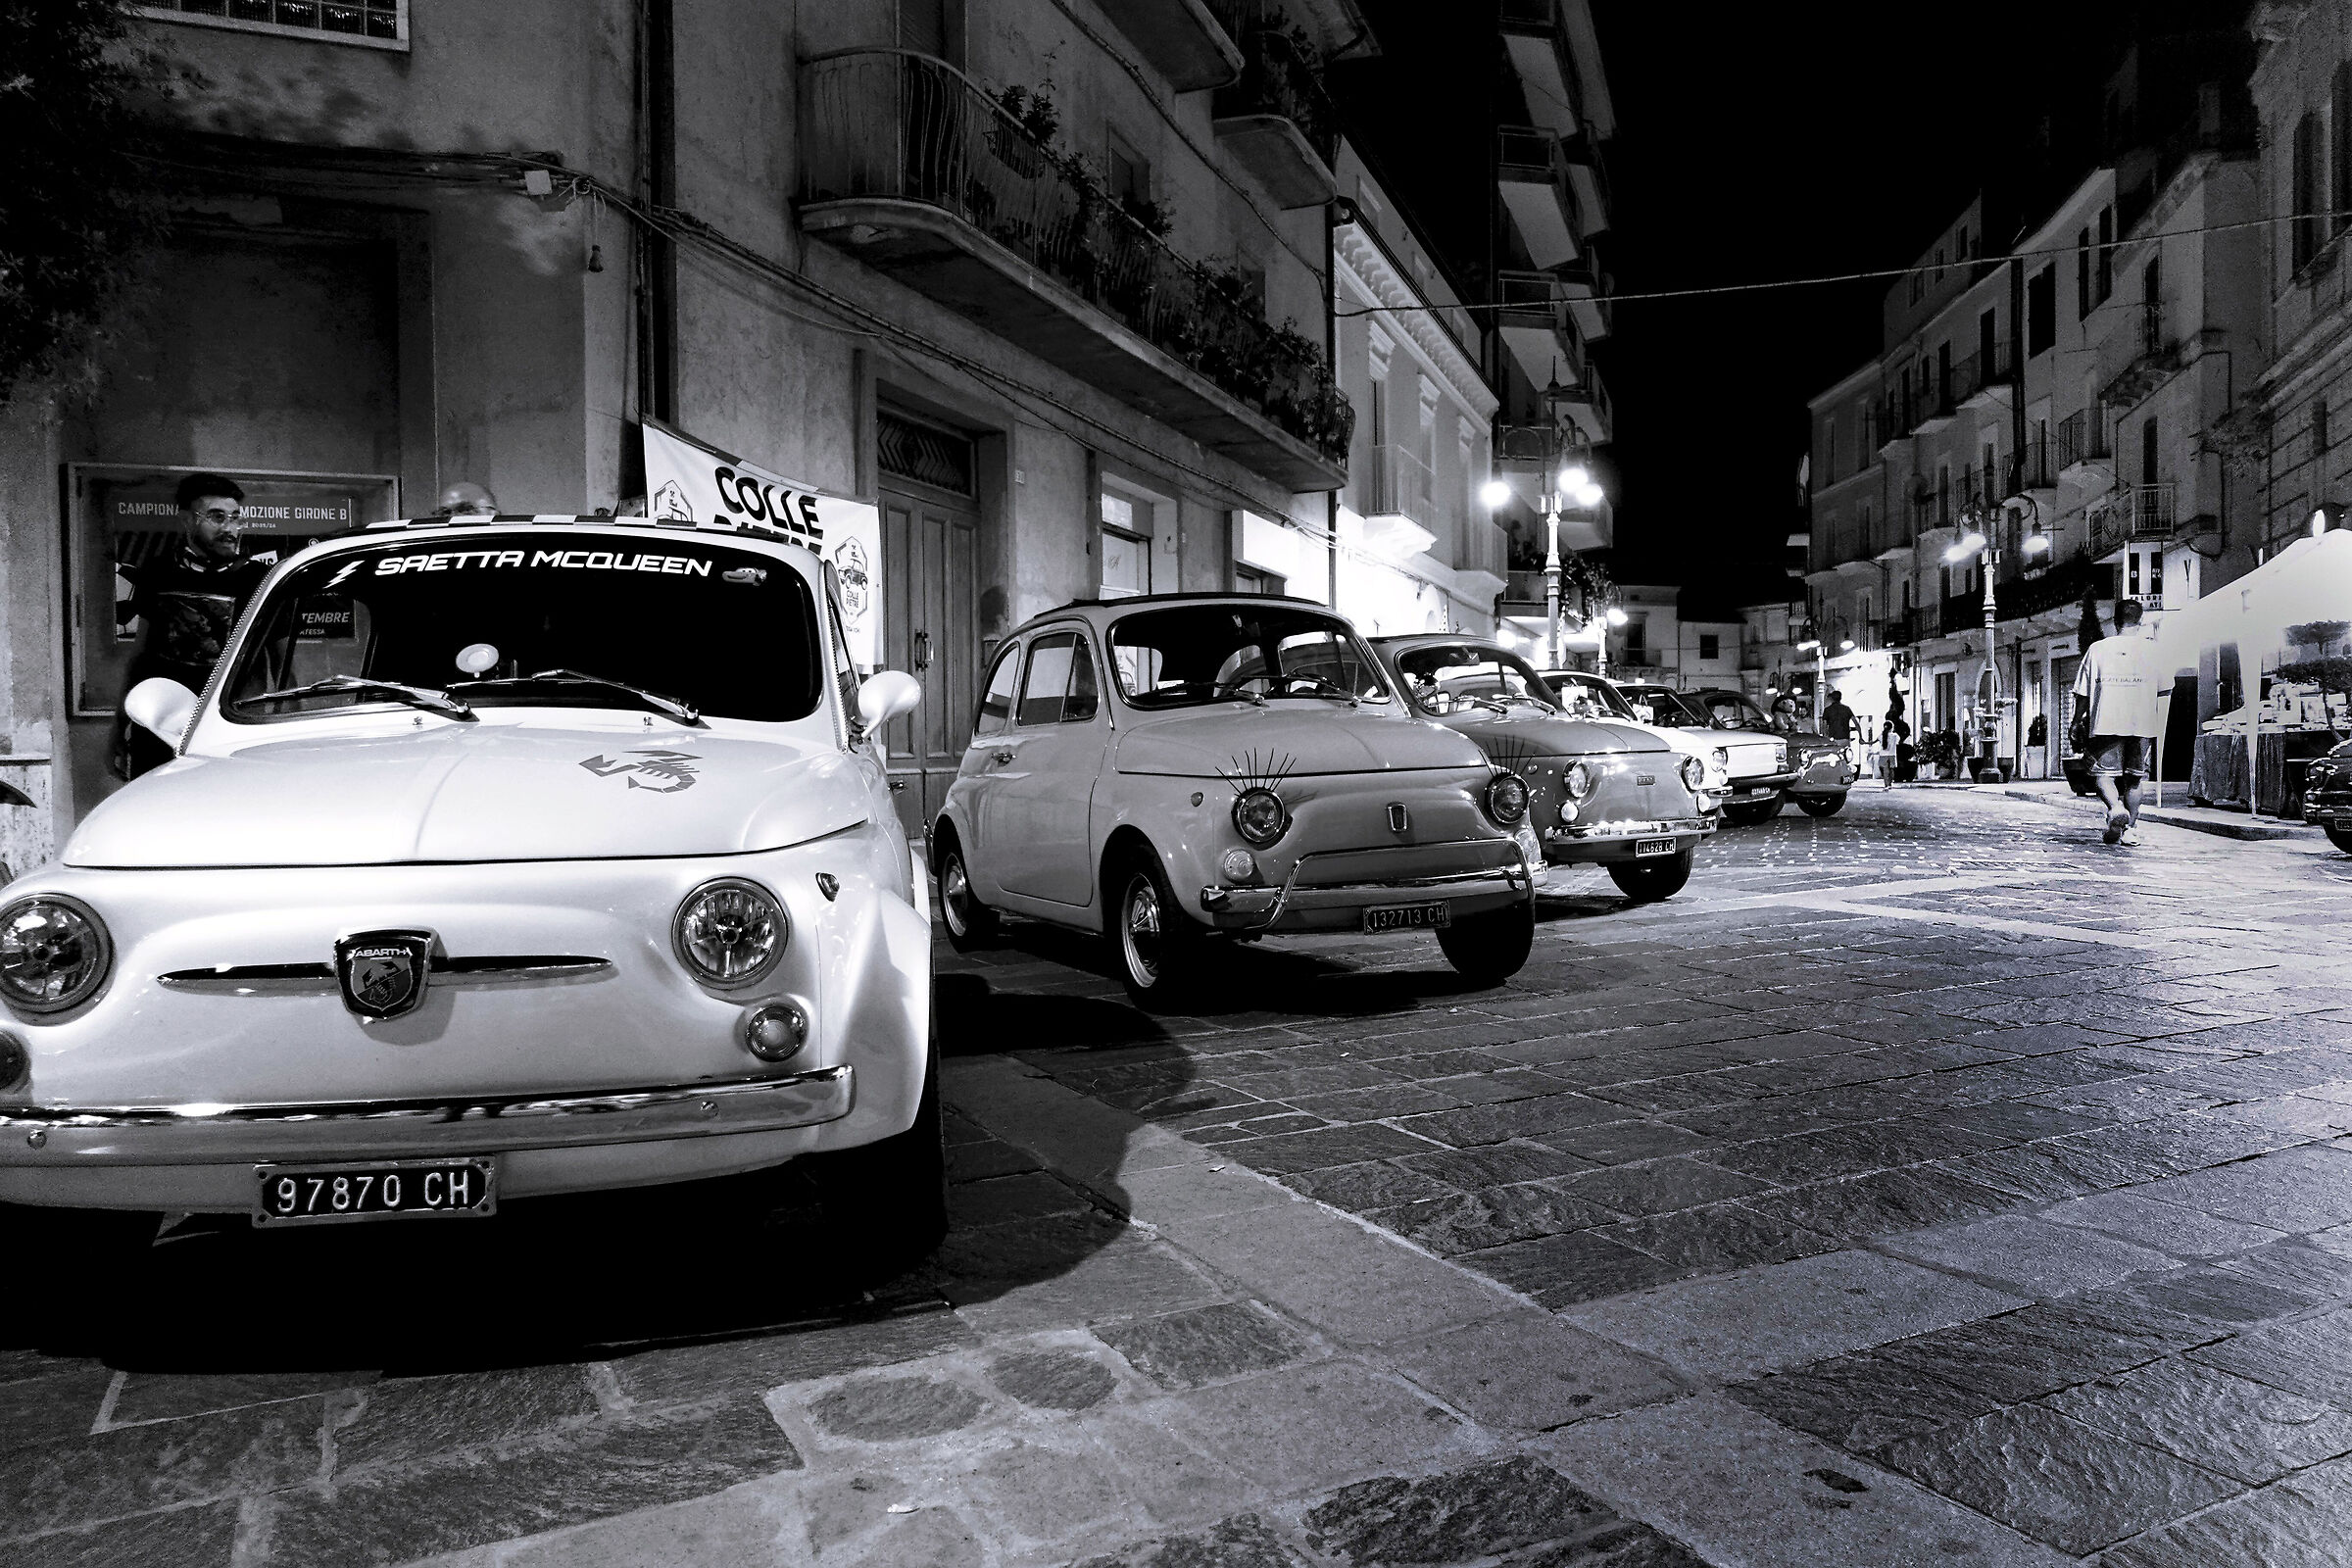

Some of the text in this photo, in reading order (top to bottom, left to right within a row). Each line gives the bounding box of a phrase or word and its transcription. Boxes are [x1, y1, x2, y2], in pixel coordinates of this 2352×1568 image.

[294, 507, 336, 520] GIRONE
[339, 508, 347, 520] B
[714, 466, 824, 540] COLLE
[374, 551, 713, 577] SAETTA MCQUEEN
[1373, 906, 1445, 928] 132713 CH
[355, 948, 407, 957] ABARTH
[276, 1169, 468, 1213] 97870 CH
